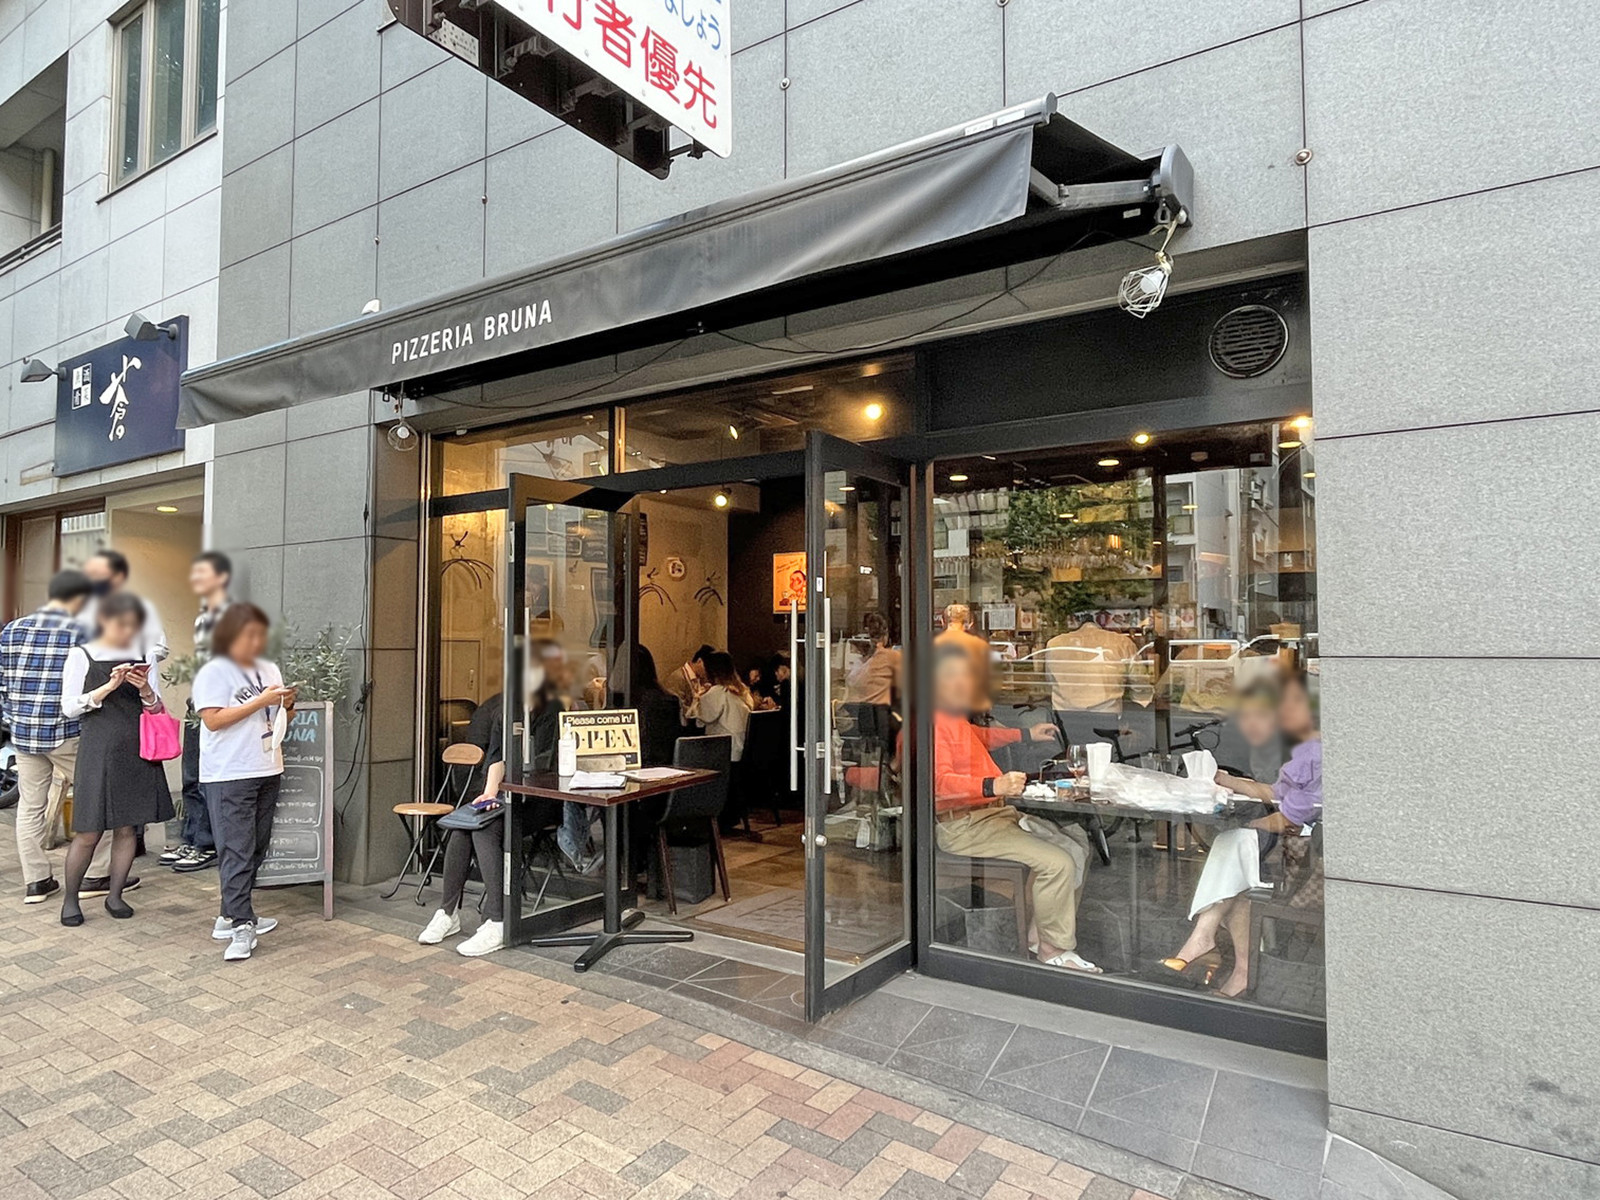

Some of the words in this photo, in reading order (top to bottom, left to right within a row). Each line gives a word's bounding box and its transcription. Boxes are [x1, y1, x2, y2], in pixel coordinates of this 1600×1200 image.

[391, 322, 474, 365] PIZZERIA
[483, 299, 552, 341] BRUNA
[566, 716, 596, 726] Please
[596, 716, 621, 724] come
